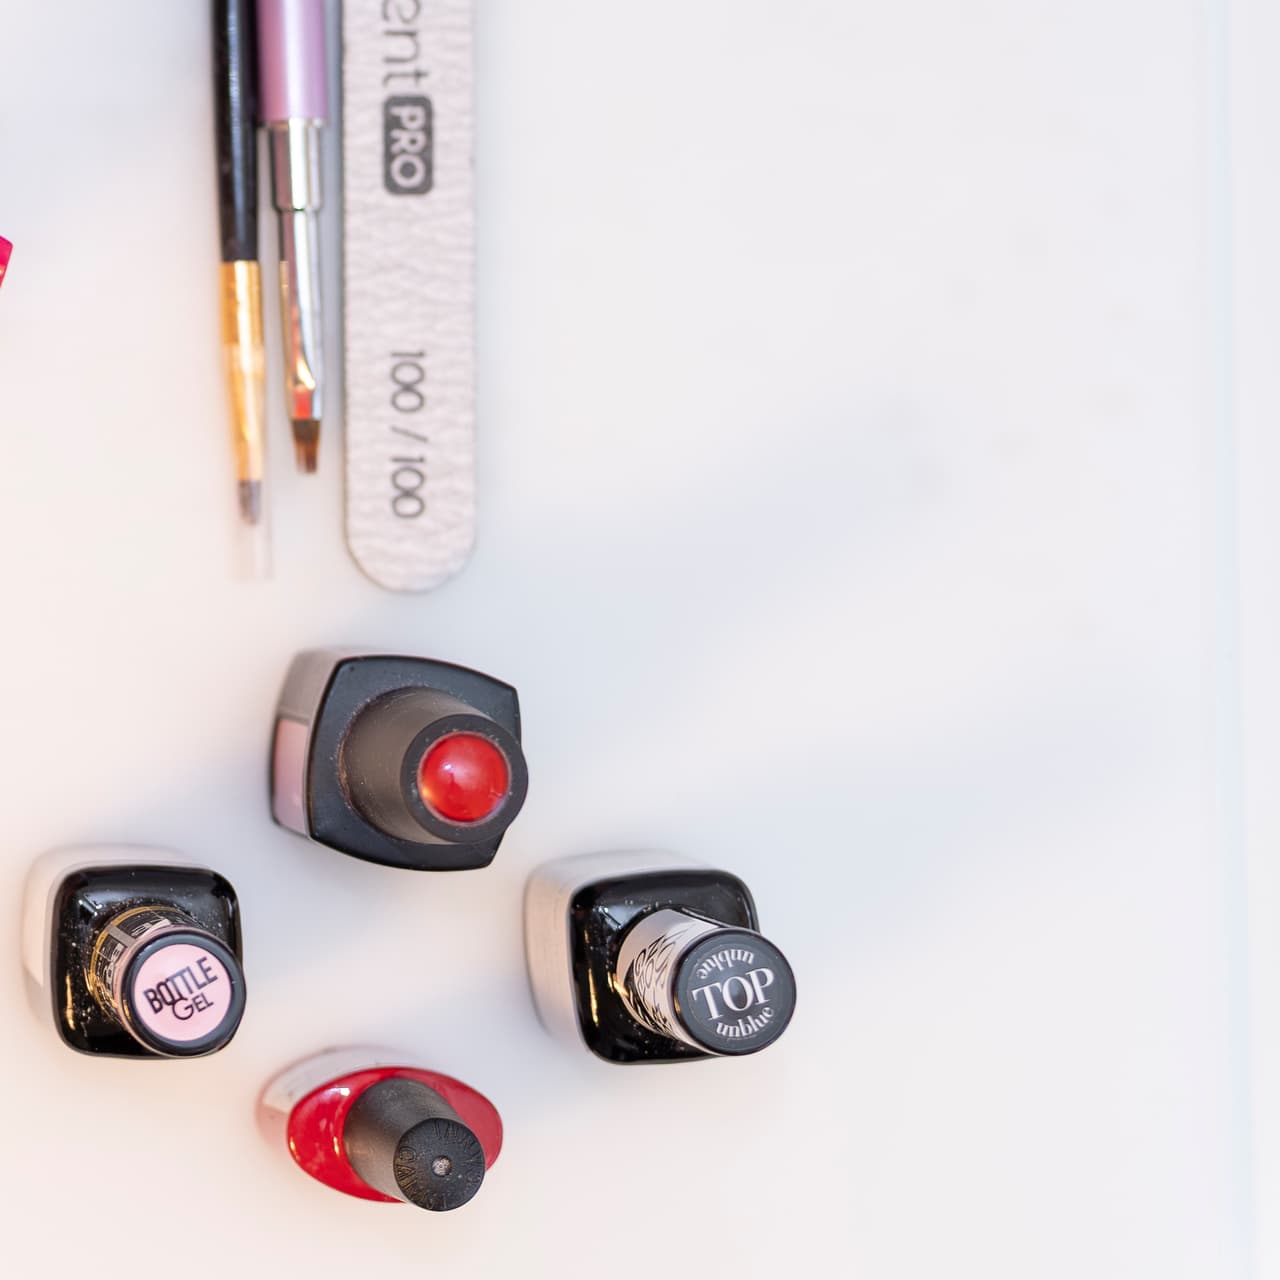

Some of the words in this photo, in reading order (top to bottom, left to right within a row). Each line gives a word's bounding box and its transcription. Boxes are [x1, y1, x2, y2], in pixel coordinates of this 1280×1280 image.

[392, 104, 426, 191] PRO
[390, 350, 424, 412] 100
[390, 455, 424, 519] 100
[143, 956, 218, 1014] BOTTLE
[172, 992, 214, 1021] GEL
[691, 967, 775, 1021] TOP
[715, 1006, 774, 1038] unblue
